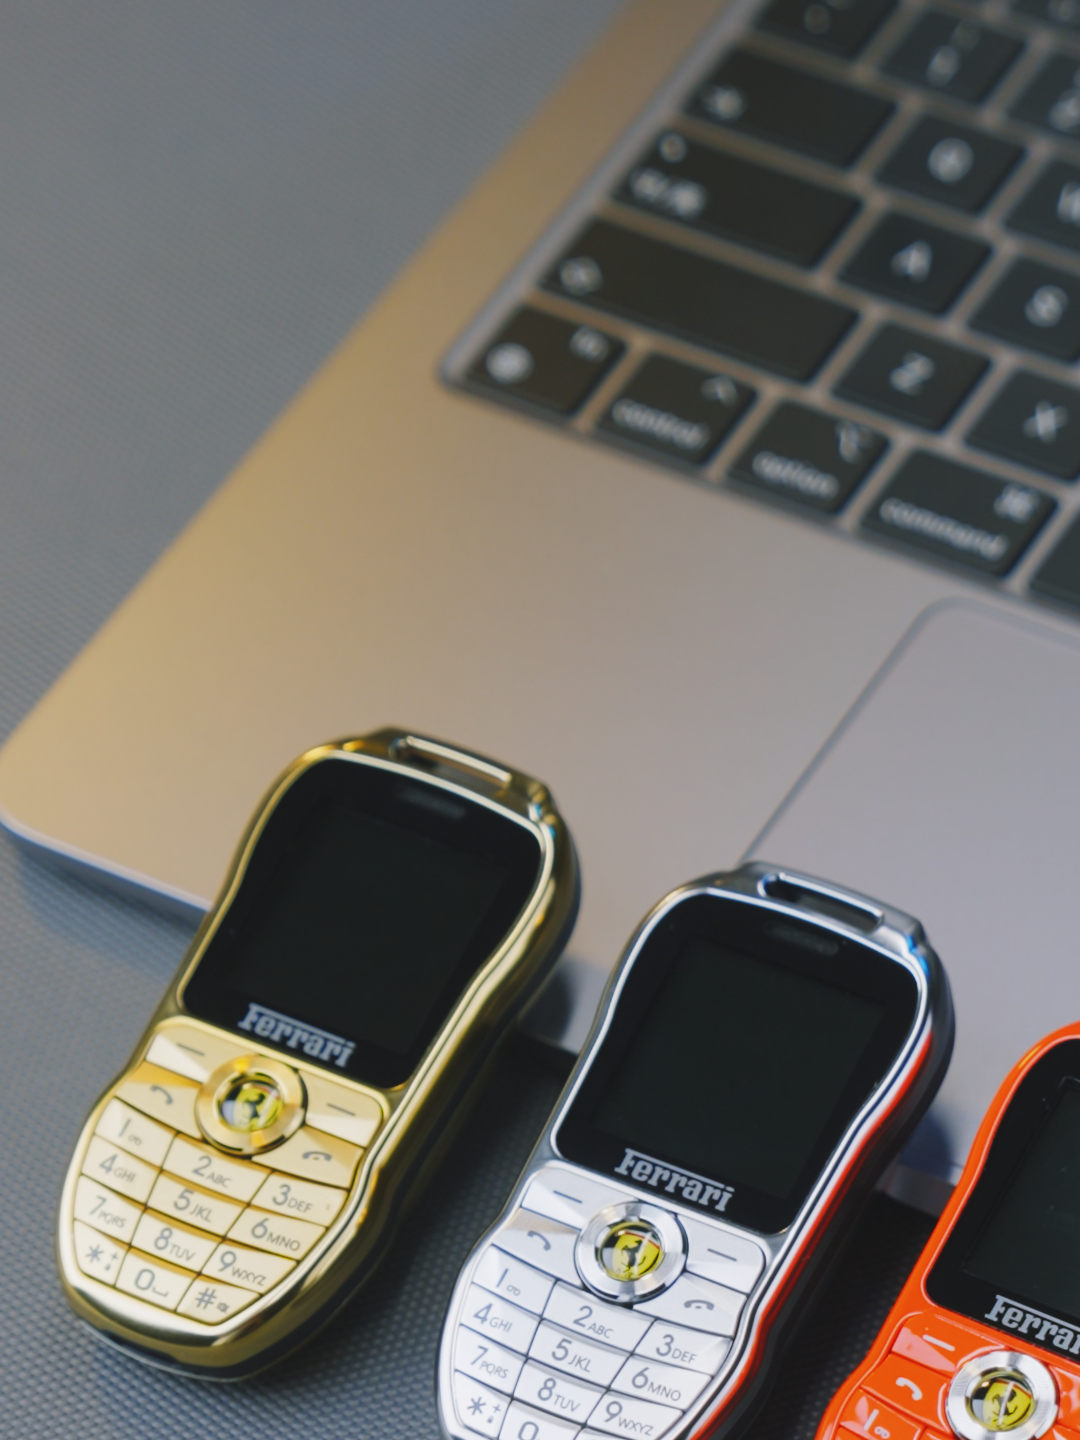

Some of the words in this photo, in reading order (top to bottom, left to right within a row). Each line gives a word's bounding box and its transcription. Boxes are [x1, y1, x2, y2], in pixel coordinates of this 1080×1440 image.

[894, 241, 932, 280] A
[1024, 402, 1067, 441] X
[880, 497, 1008, 560] command
[237, 1002, 357, 1068] Ferrari
[614, 1148, 735, 1212] Ferrari
